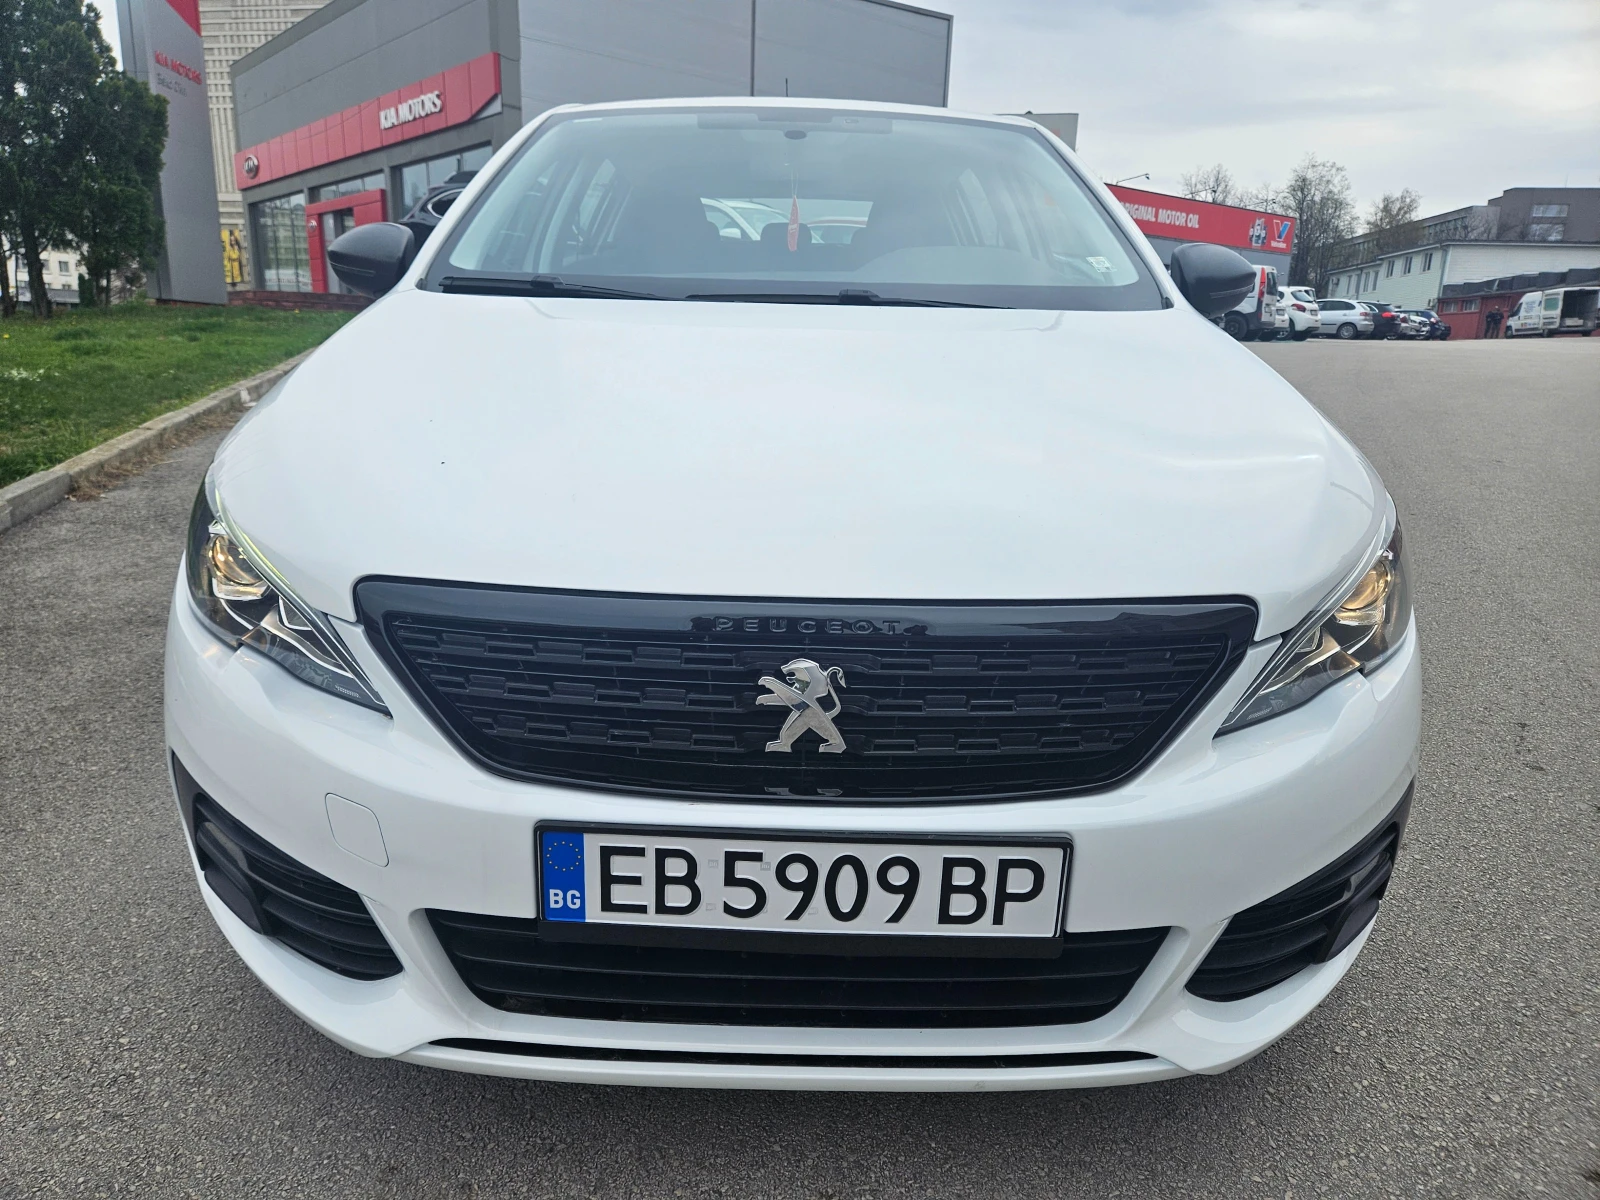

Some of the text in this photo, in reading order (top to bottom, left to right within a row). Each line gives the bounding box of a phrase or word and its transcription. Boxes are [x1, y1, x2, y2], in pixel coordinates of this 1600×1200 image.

[154, 50, 169, 68] KIA
[171, 59, 203, 85] MOTORS
[379, 91, 442, 130] KIA MOTORS
[1157, 208, 1186, 227] MOTOR
[1187, 213, 1199, 229] OIL
[715, 616, 901, 636] PEUGEOT
[599, 844, 1045, 926] EB 5909 BP
[549, 889, 581, 910] BG
